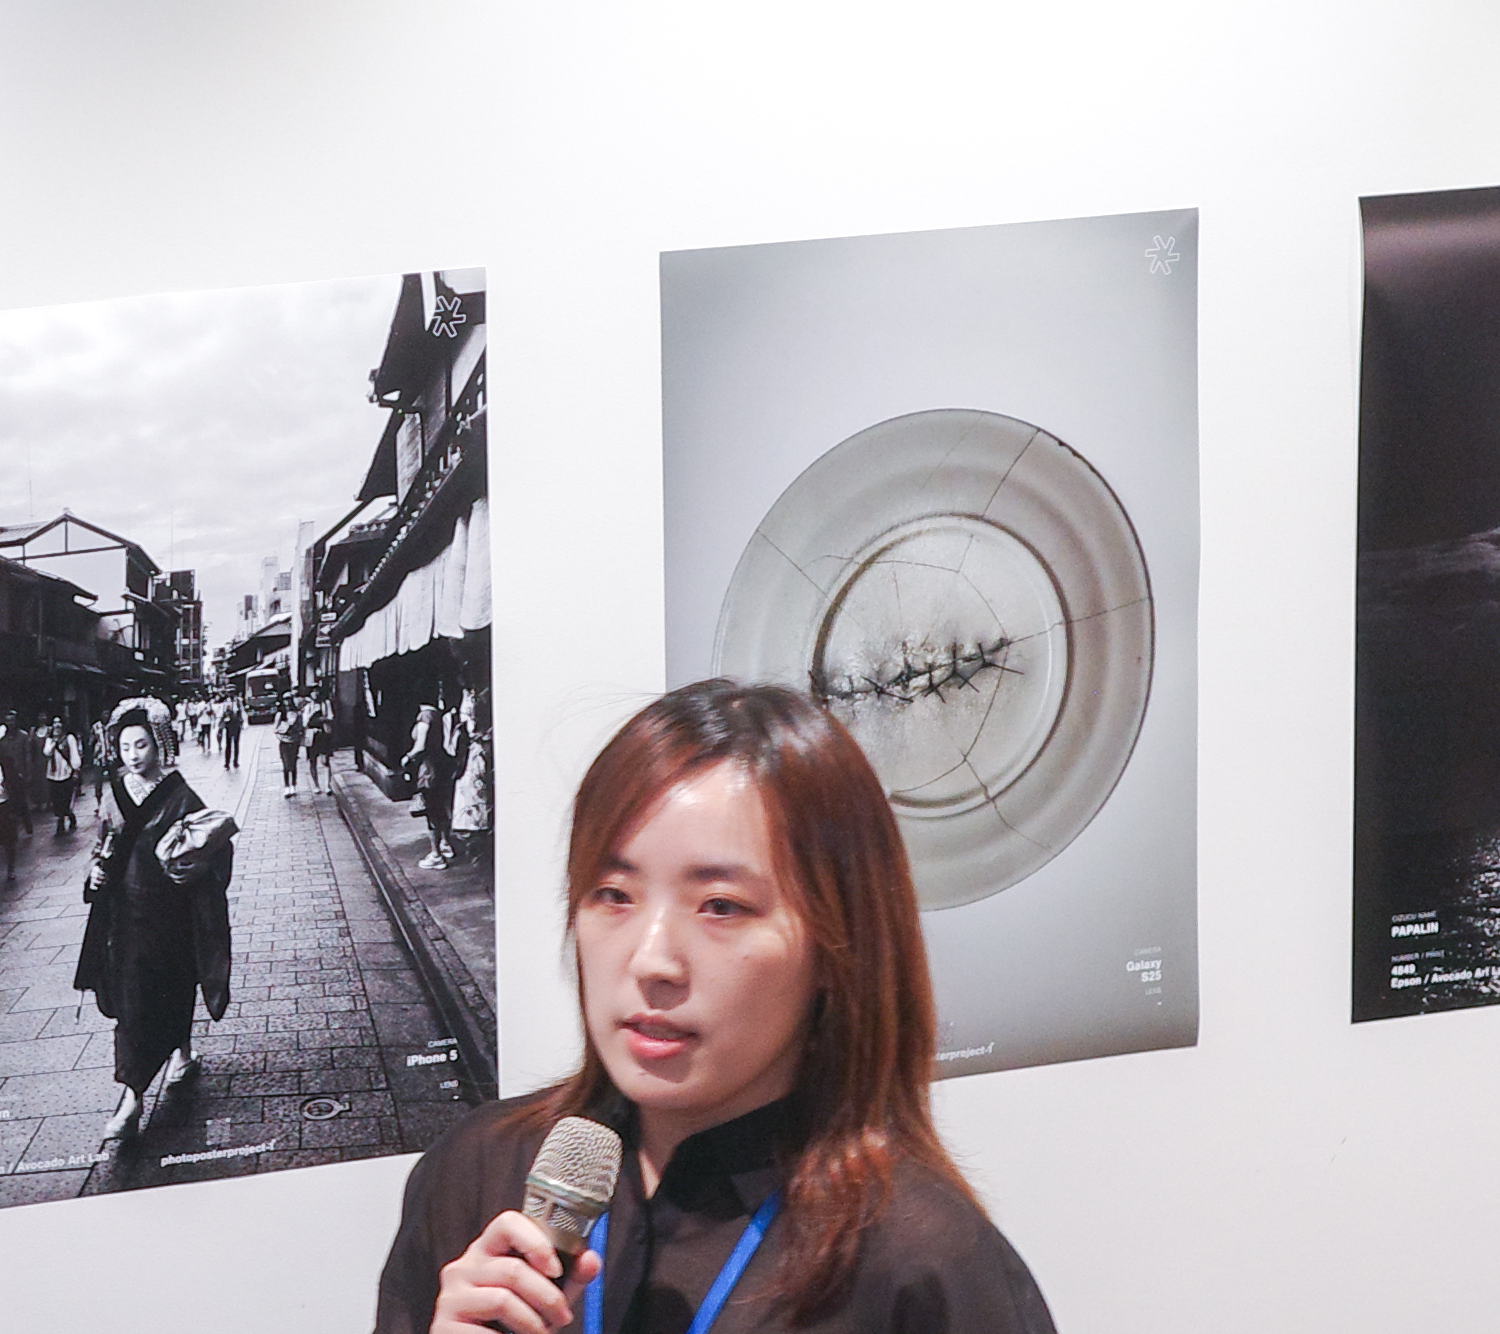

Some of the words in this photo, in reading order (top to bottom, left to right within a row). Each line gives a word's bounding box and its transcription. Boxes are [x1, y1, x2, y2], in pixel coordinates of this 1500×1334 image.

[1391, 921, 1439, 938] PAPALIN
[1126, 959, 1162, 972] Galaxy
[1141, 970, 1162, 982] S25
[1391, 976, 1422, 989] Epson
[1431, 969, 1473, 983] Avocado
[1474, 967, 1490, 978] Art
[407, 1053, 447, 1067] iPhone
[15, 1157, 66, 1172] Avocado
[68, 1154, 87, 1166] Art
[88, 1151, 110, 1163] Lab
